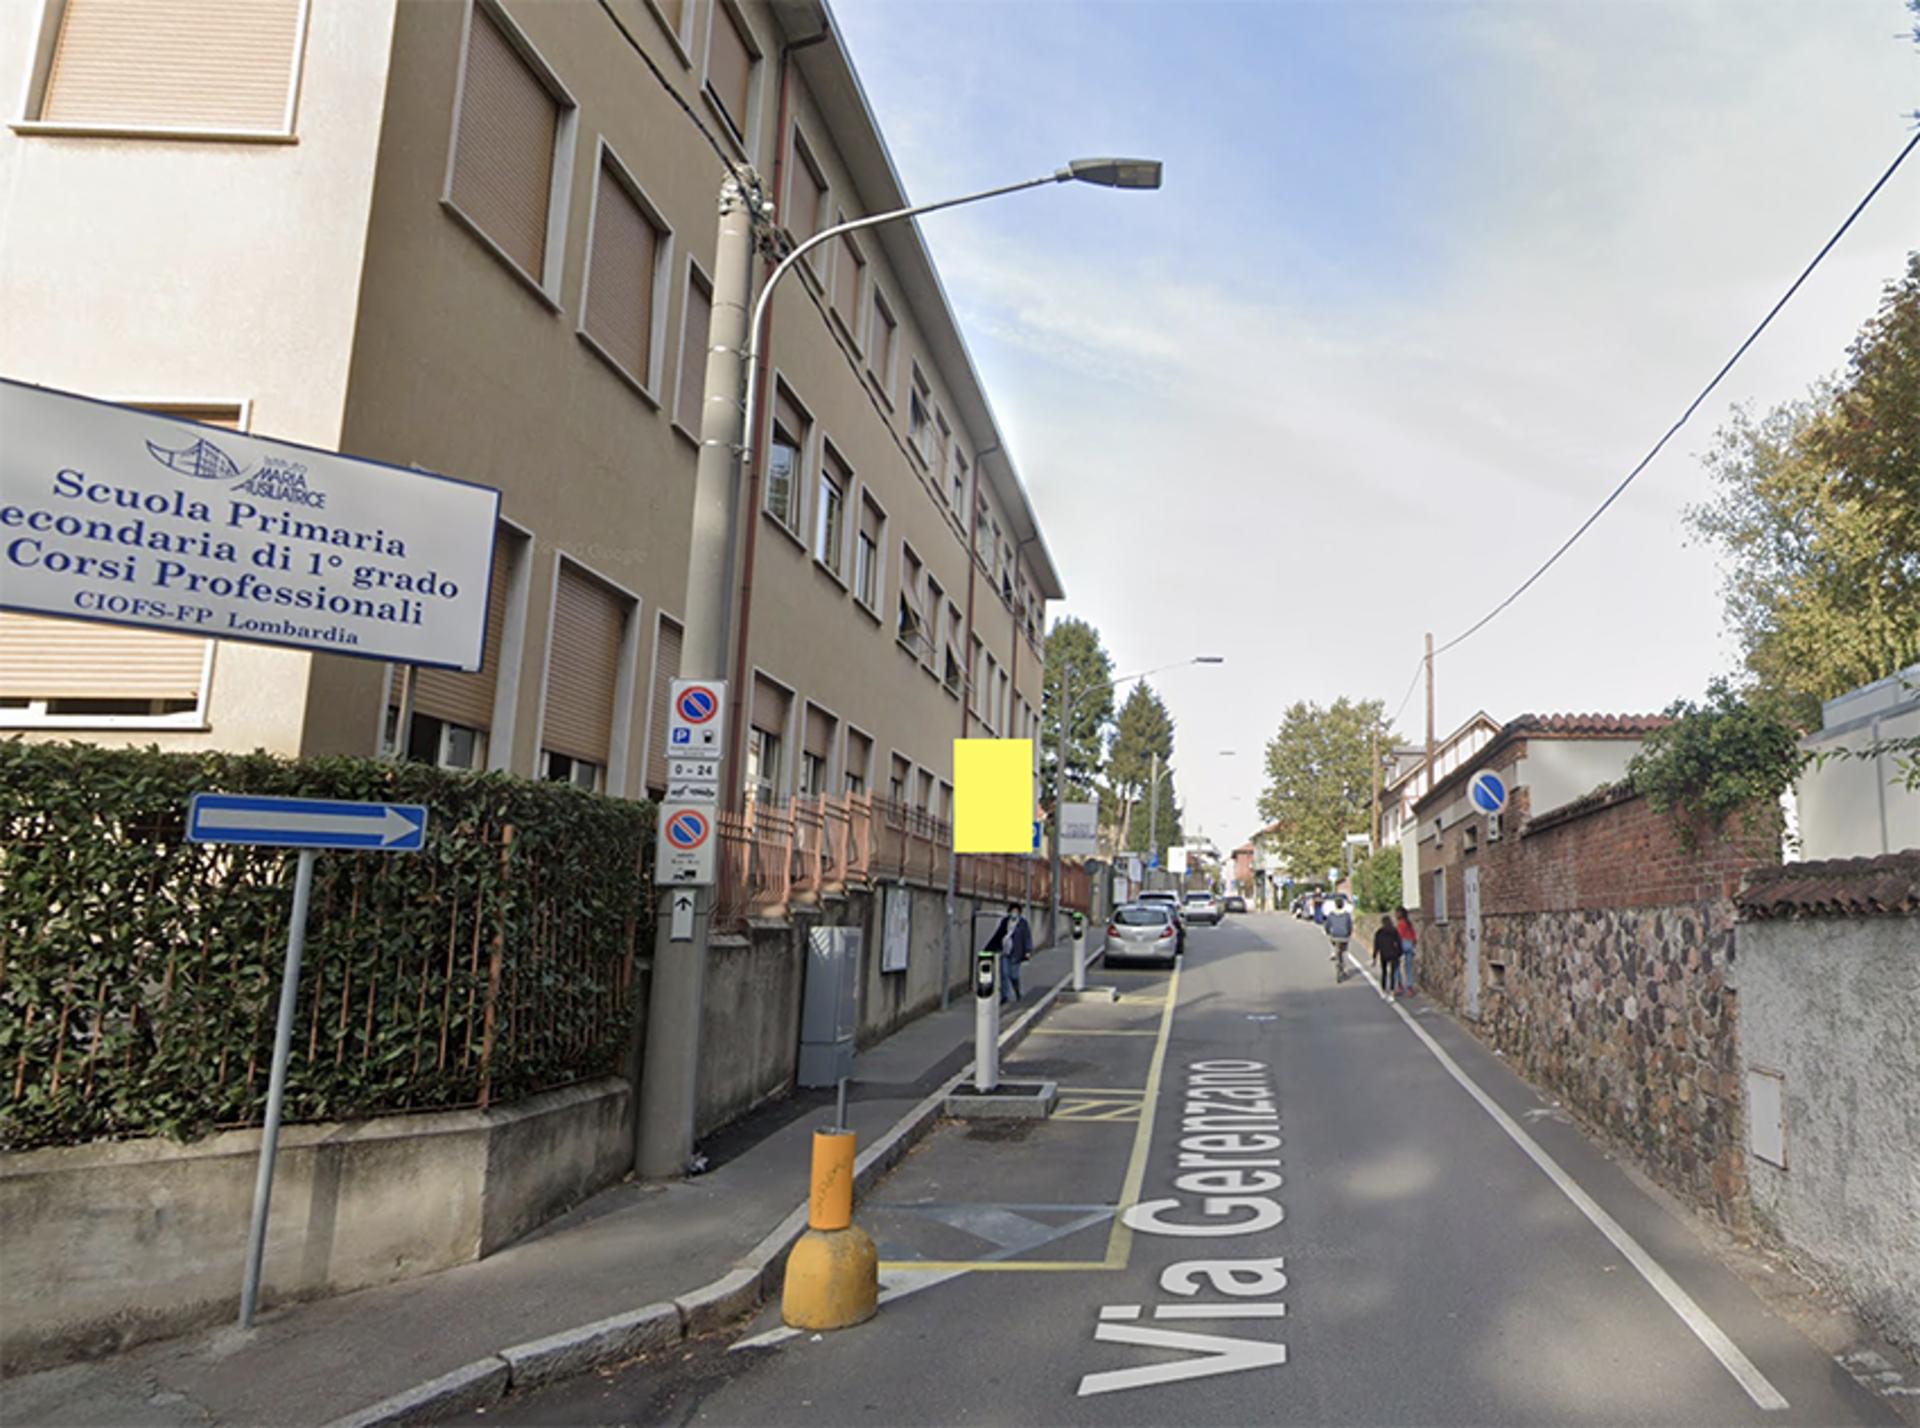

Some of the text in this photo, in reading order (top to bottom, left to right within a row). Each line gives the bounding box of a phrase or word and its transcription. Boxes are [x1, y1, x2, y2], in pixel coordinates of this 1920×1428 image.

[53, 468, 406, 558] Scuola Primaria
[252, 467, 307, 488] MARIA
[0, 505, 237, 562] econdaria
[252, 542, 291, 571] di
[352, 566, 459, 599] grado
[7, 537, 423, 626] Corsi Professionali
[74, 590, 359, 645] CIOFS-FP Lombardia
[697, 764, 712, 776] 24
[1077, 1059, 1288, 1396] Via Gerenzano
